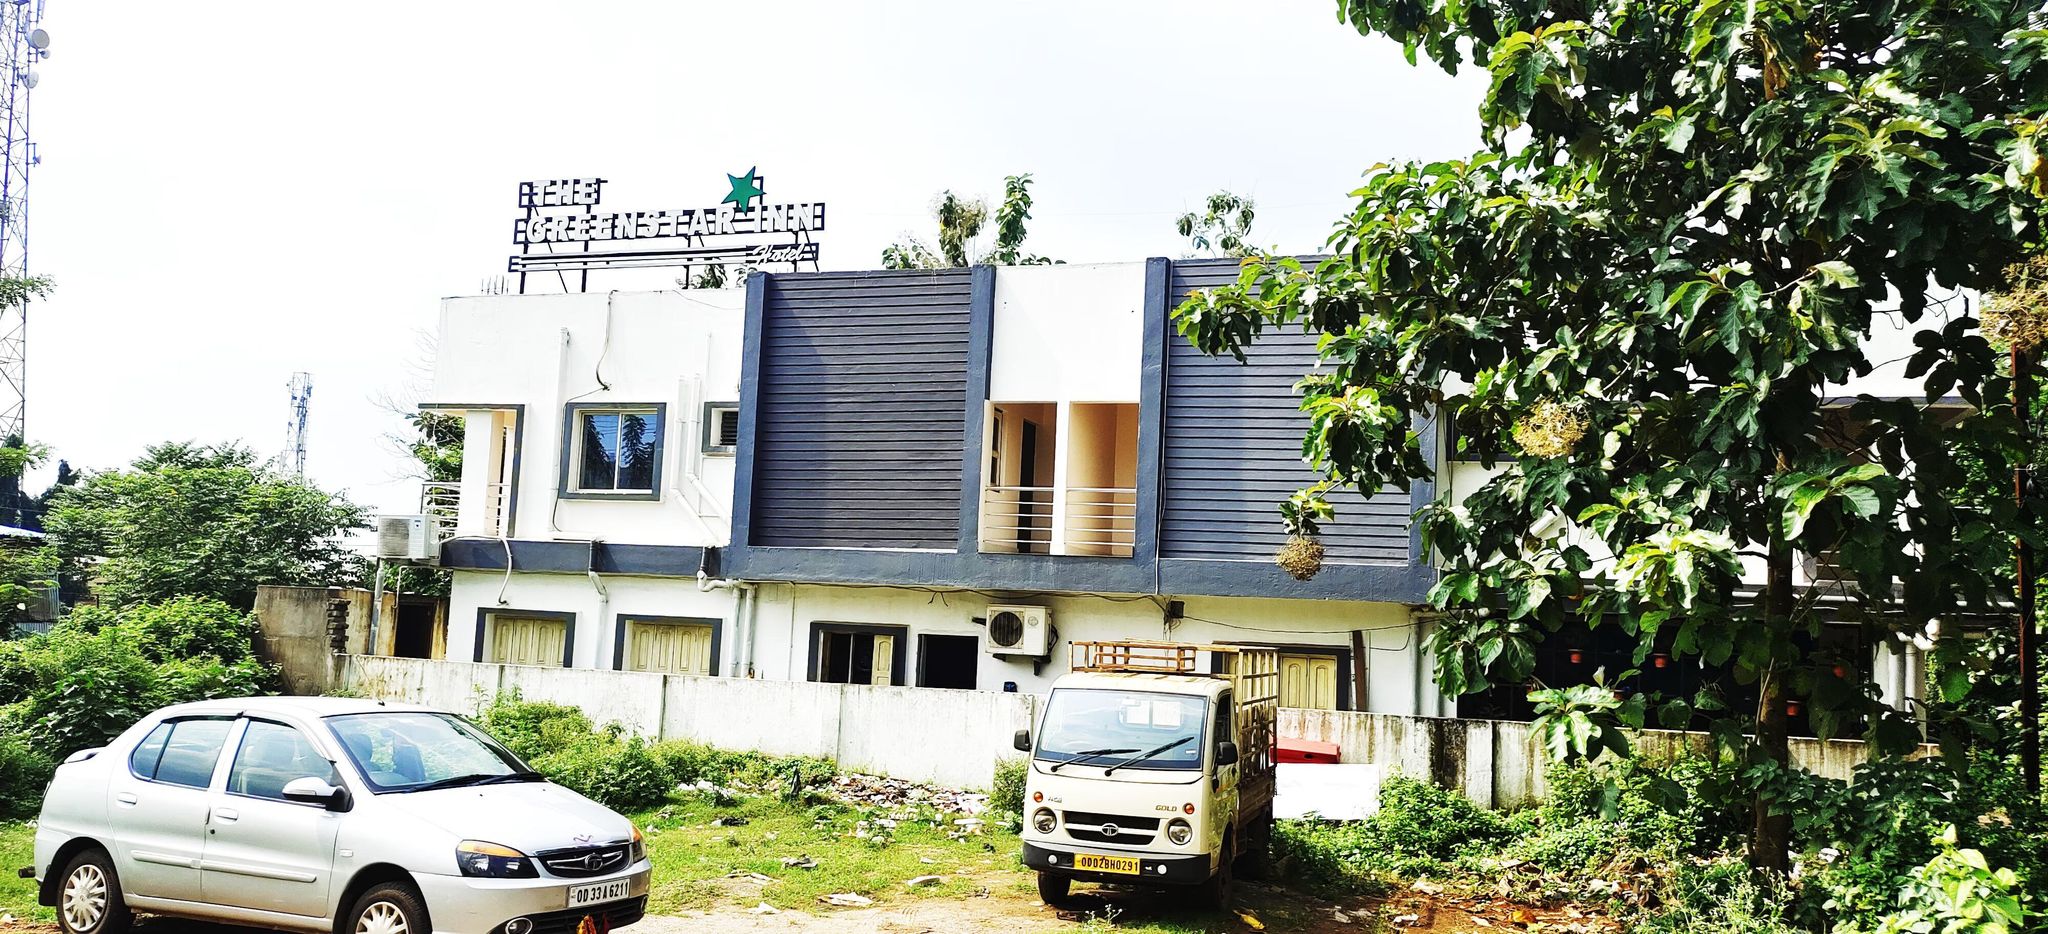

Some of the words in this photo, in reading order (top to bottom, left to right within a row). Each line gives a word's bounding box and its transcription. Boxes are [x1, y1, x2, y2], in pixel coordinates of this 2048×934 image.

[532, 178, 599, 206] THE
[526, 206, 736, 243] GREENSTAR
[753, 202, 815, 233] INN
[752, 243, 806, 265] Hotel
[1155, 804, 1178, 812] GOLD
